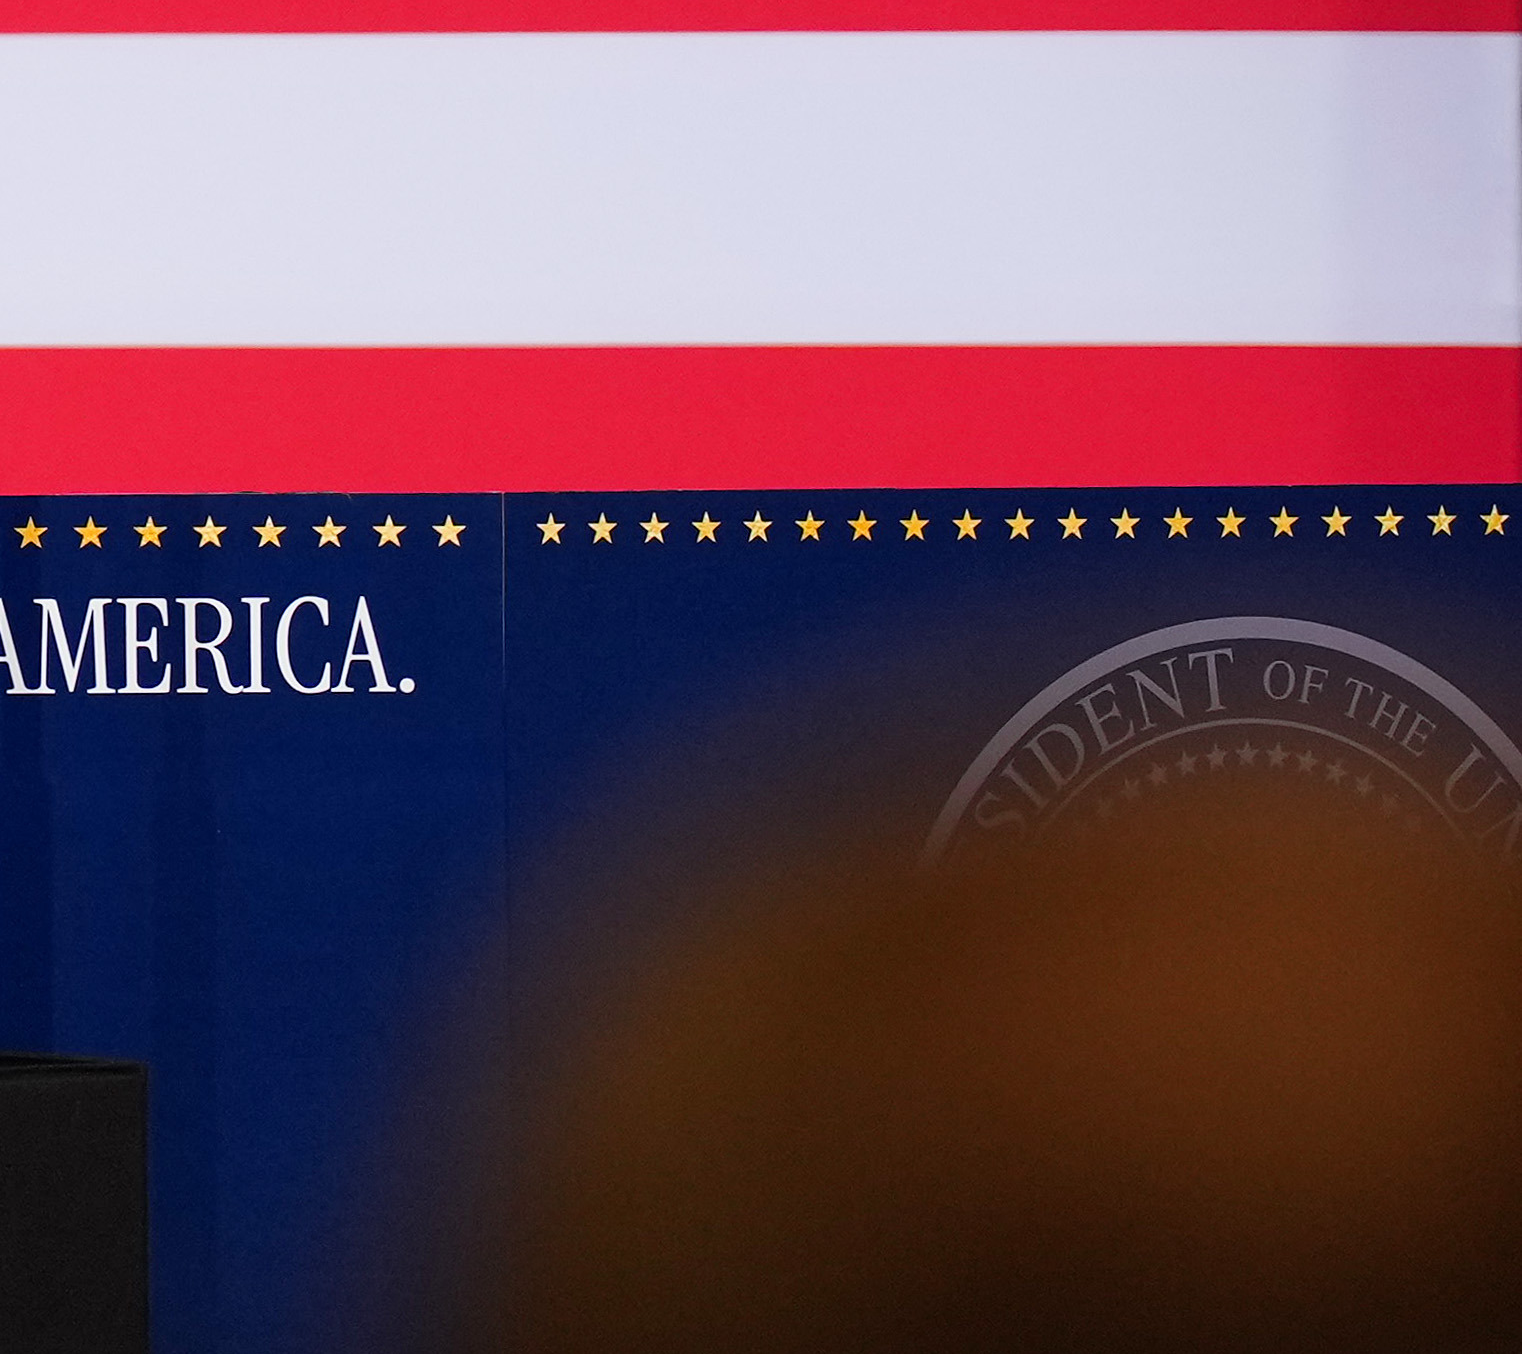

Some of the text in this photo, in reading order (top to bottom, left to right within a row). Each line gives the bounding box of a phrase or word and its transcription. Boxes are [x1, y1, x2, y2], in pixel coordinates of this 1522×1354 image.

[974, 647, 1438, 841] SIDENT OF THE
